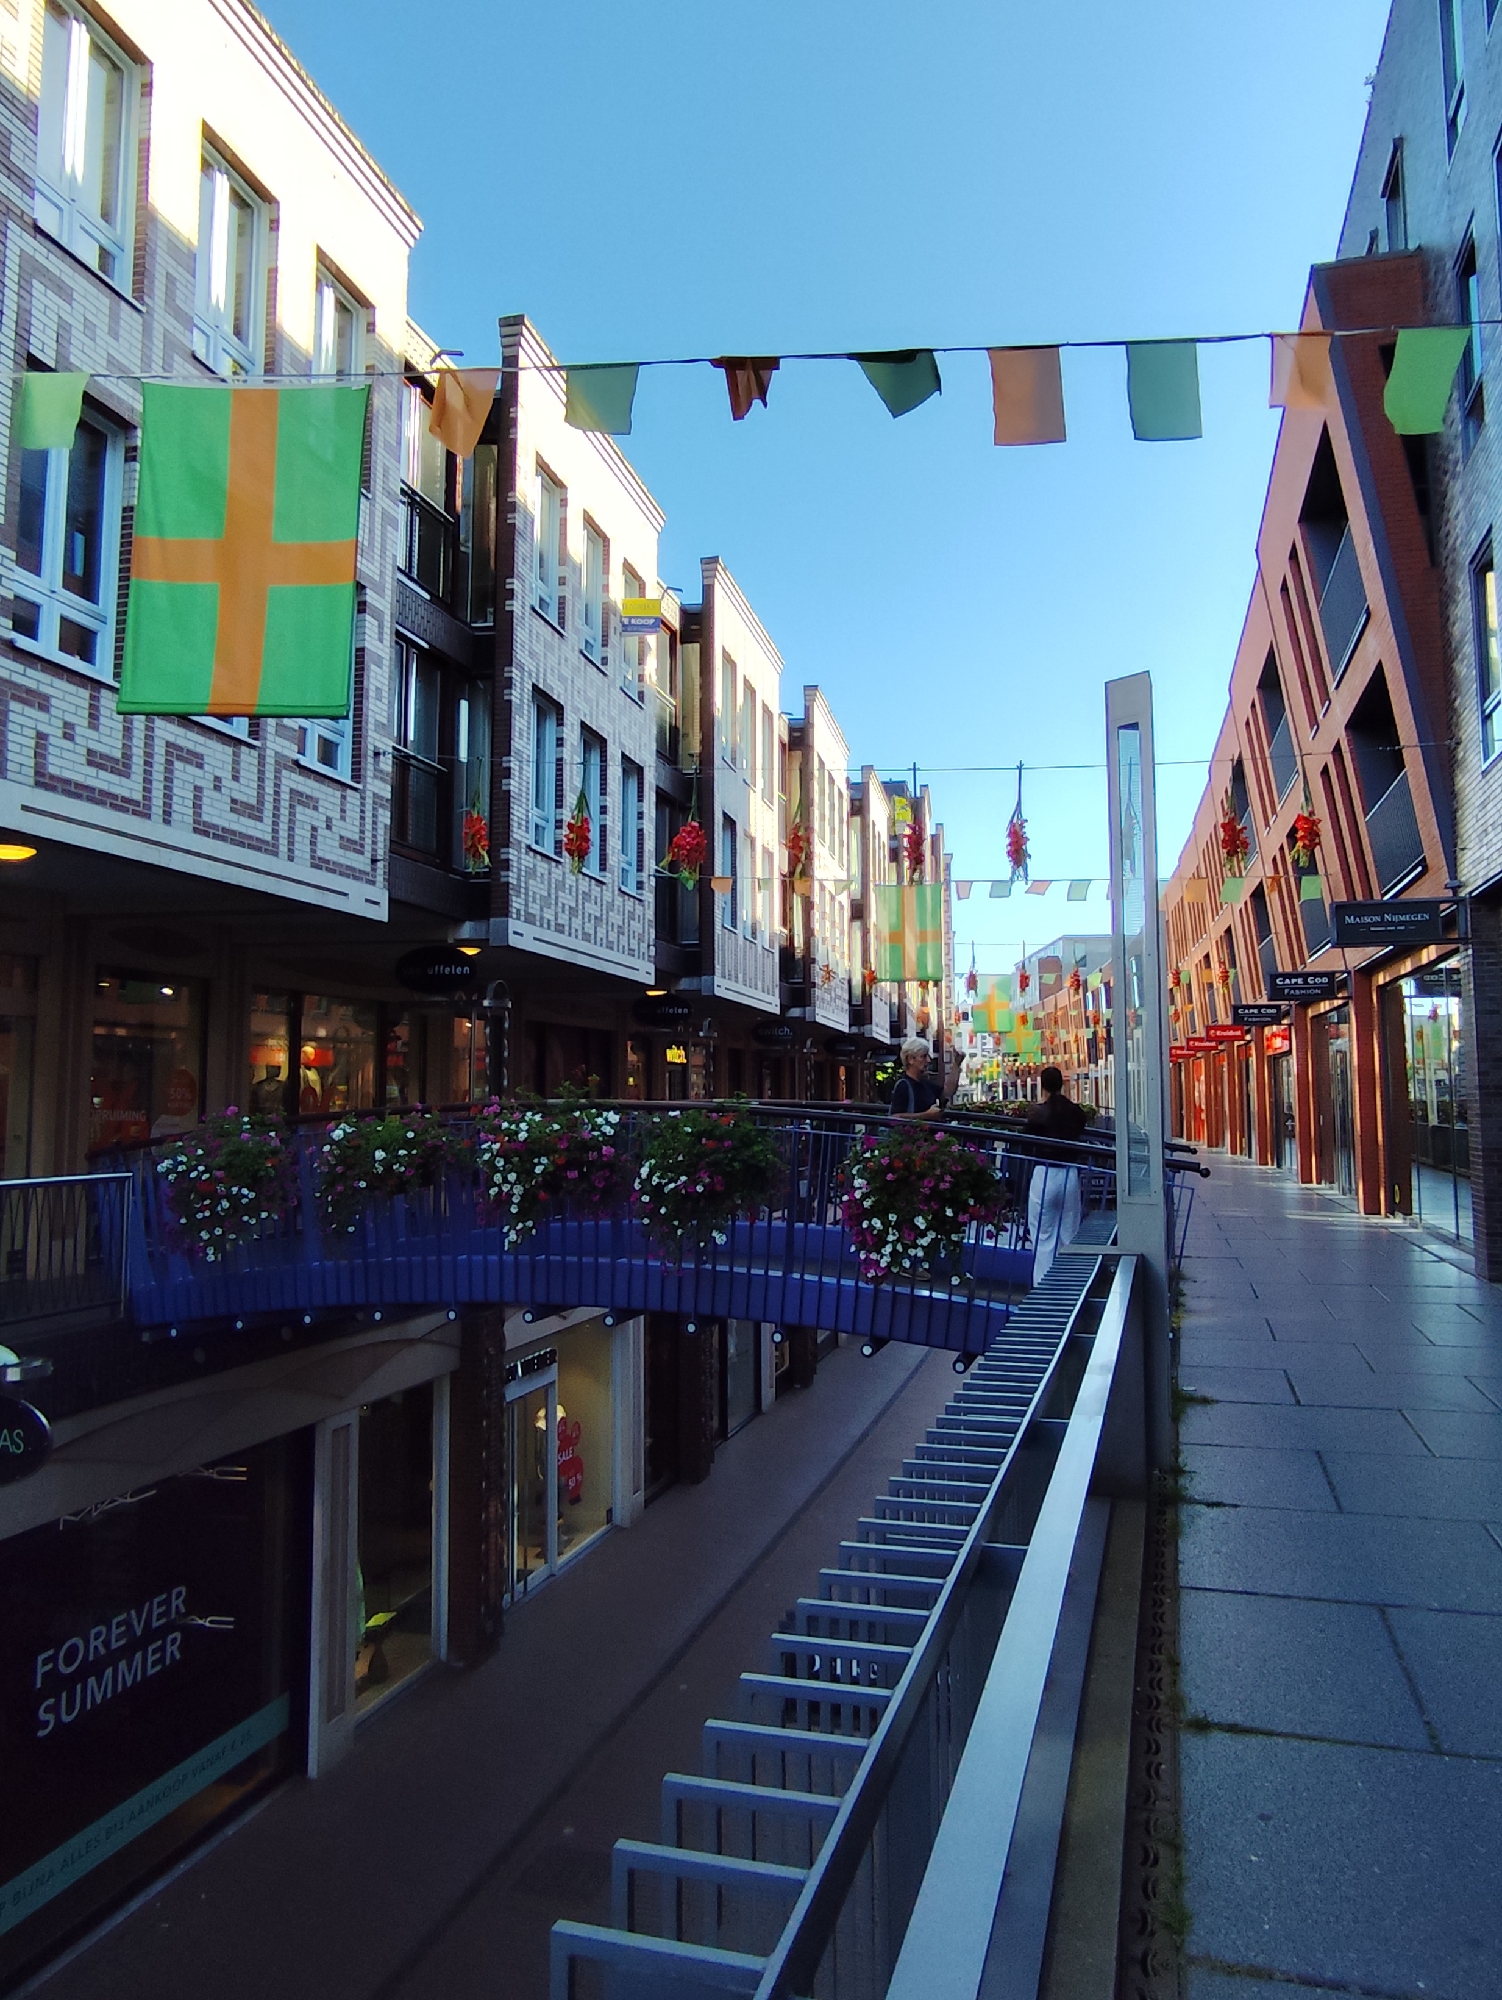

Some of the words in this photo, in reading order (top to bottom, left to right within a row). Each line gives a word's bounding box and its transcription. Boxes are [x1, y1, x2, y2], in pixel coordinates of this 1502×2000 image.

[1344, 915, 1382, 925] MAISON
[1383, 913, 1430, 924] NIJMEGEN
[426, 963, 471, 976] uffelen
[1275, 977, 1304, 985] CAPE
[1307, 976, 1329, 985] COD
[1284, 988, 1322, 996] FASHION
[557, 1446, 573, 1466] SALE
[34, 1584, 187, 1690] FOREVER
[36, 1631, 182, 1738] SUMMER
[59, 1833, 102, 1872] ALLES
[104, 1822, 125, 1841] BIJ
[128, 1773, 190, 1825] AANKOOP
[191, 1745, 229, 1779] VANAF
